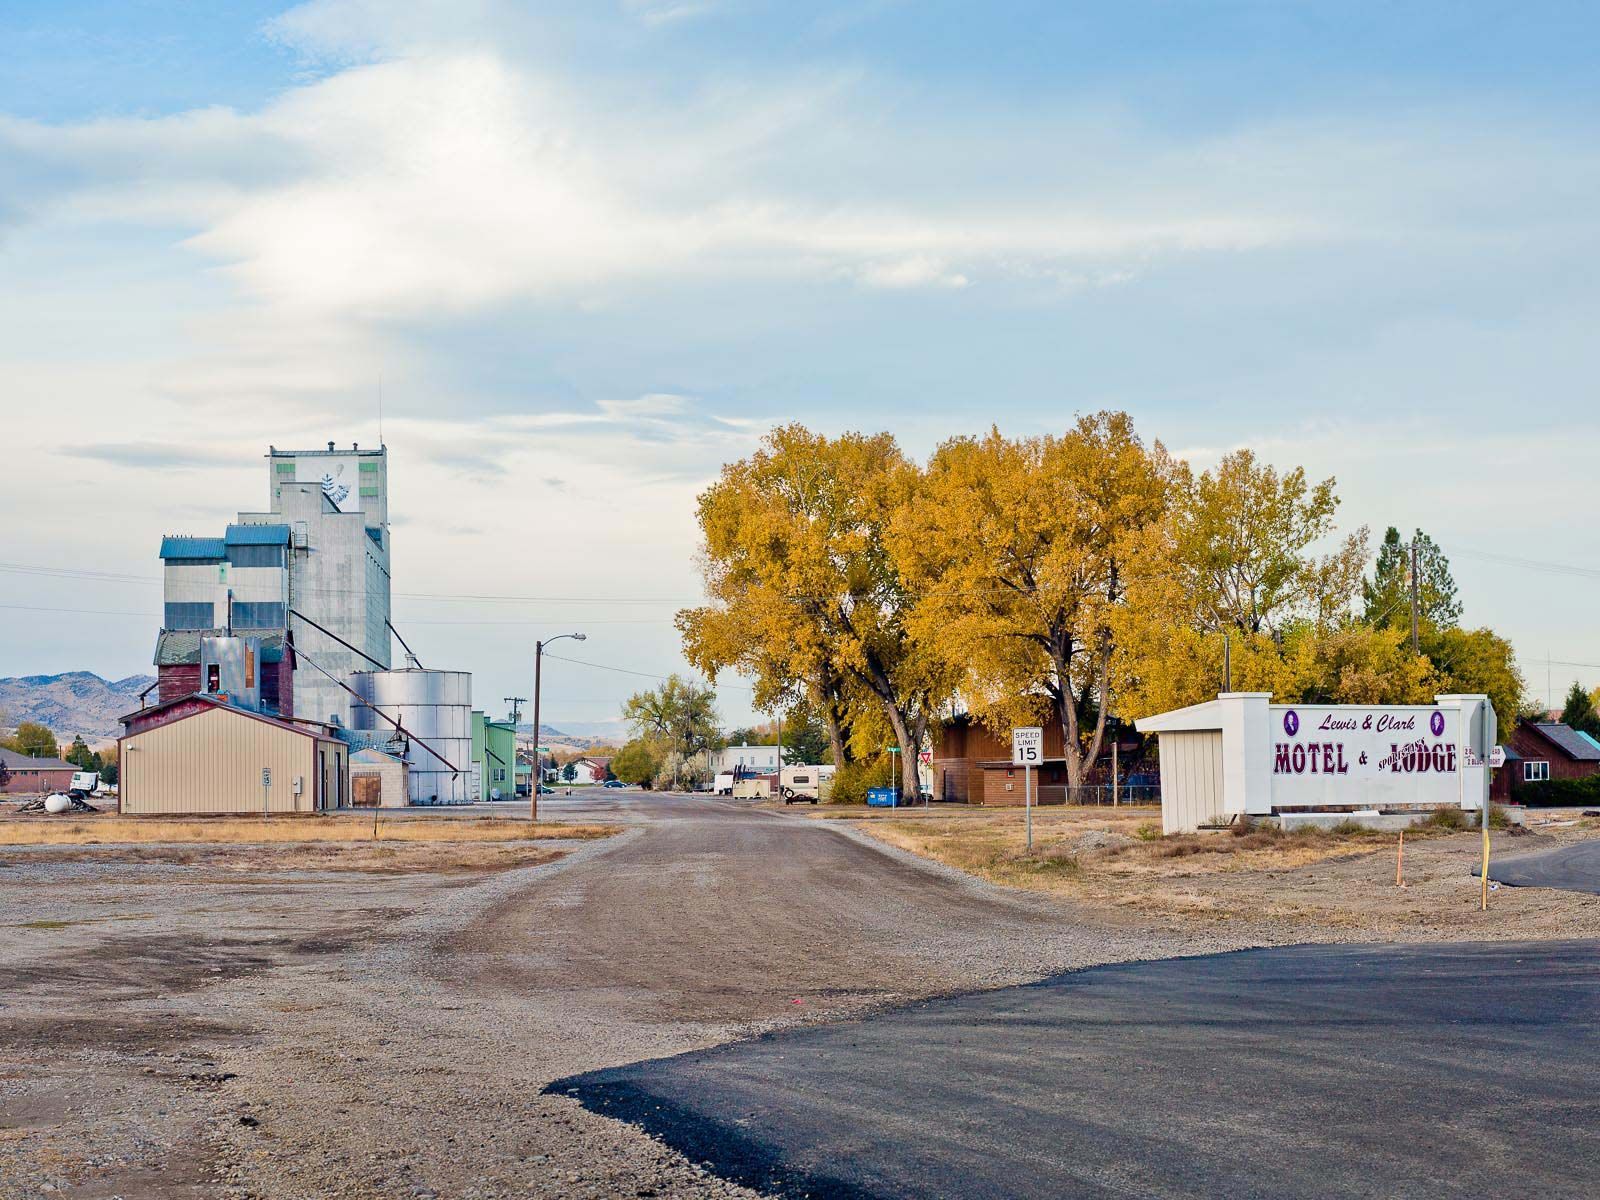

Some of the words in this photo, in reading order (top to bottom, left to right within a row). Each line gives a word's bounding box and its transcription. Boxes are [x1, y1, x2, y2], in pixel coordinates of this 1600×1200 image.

[1318, 713, 1358, 731] Lewis
[1362, 714, 1373, 730] &
[1376, 713, 1416, 733] Clark
[1018, 748, 1036, 760] 15
[1273, 742, 1349, 775] MOTEL
[1358, 750, 1368, 765] &
[1390, 742, 1457, 773] LODGE
